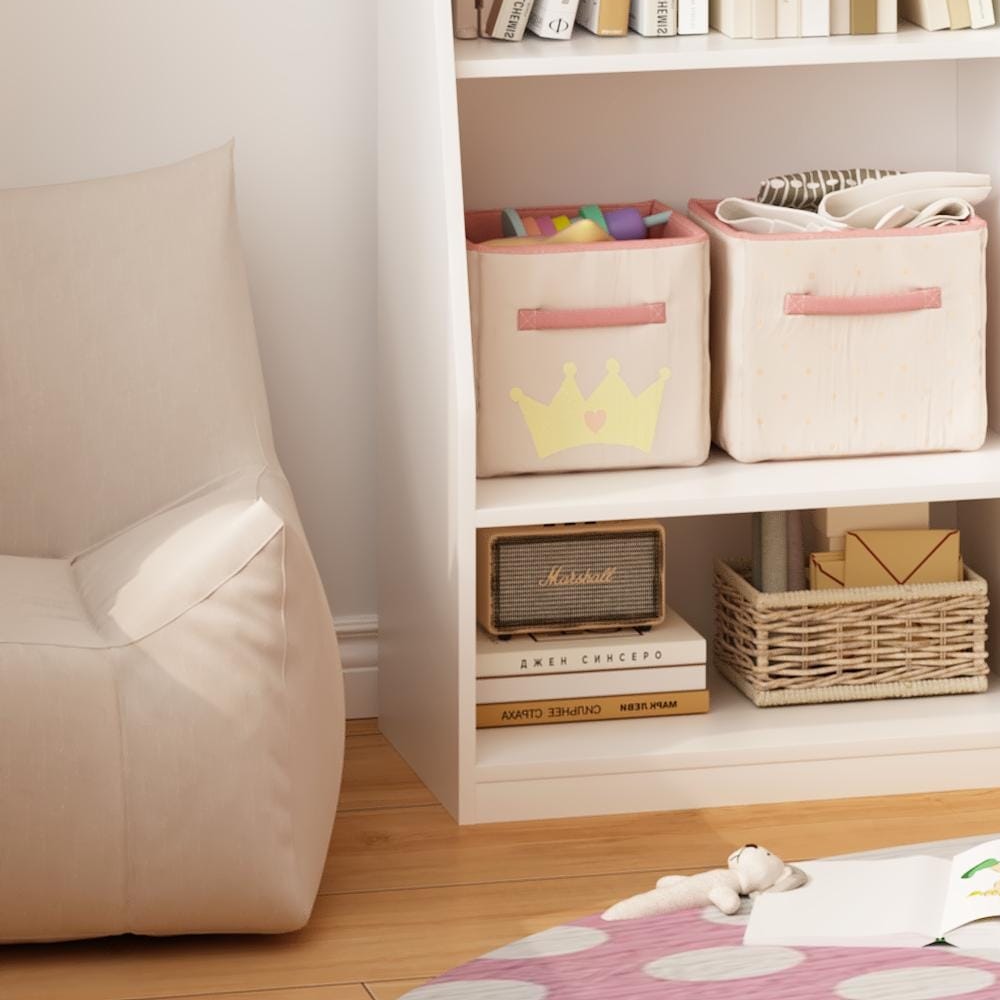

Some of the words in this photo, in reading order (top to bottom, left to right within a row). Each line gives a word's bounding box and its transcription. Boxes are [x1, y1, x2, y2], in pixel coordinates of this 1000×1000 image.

[538, 565, 617, 587] Marshall
[520, 656, 568, 669] ДЖЕН
[581, 650, 663, 664] СИНСЕРО
